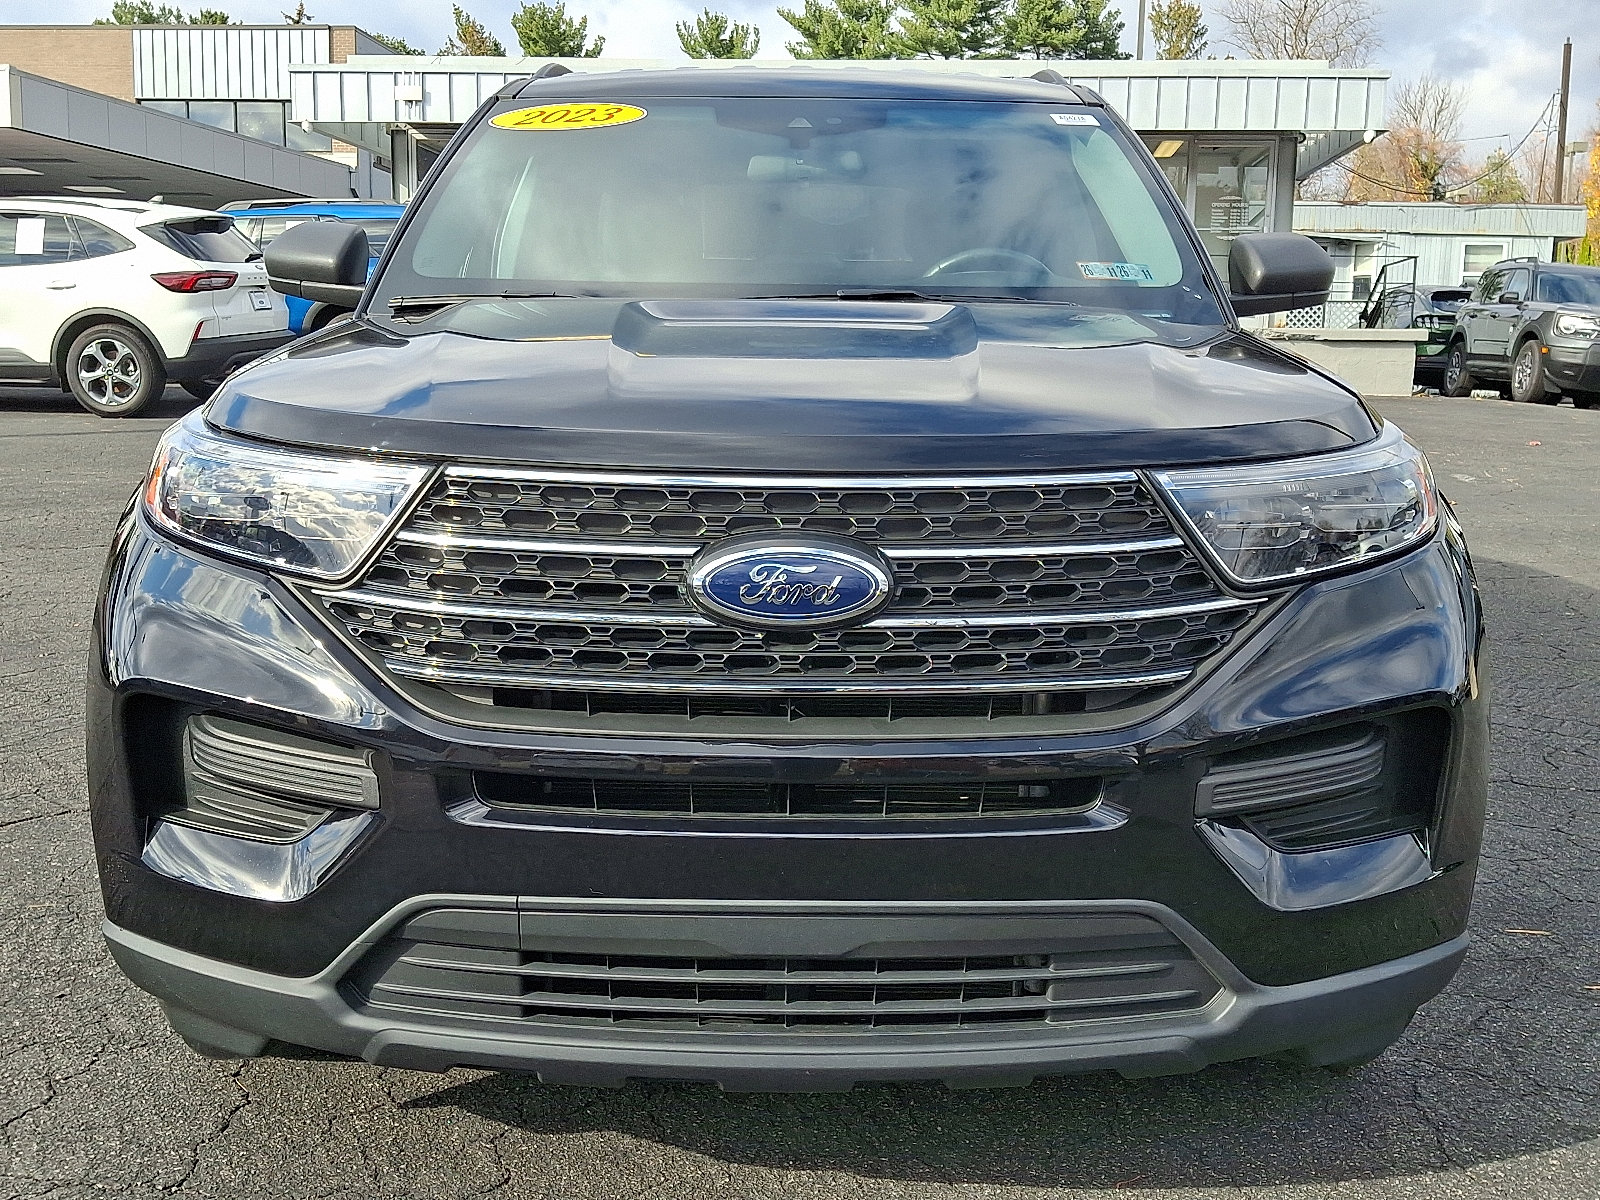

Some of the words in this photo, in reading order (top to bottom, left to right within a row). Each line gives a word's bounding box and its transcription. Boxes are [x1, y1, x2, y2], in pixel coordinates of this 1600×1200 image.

[513, 107, 623, 126] 2023
[1080, 264, 1094, 276] 26
[1106, 267, 1119, 278] 11
[1115, 265, 1130, 277] 26
[1141, 269, 1154, 280] 11
[739, 563, 843, 606] Ford
